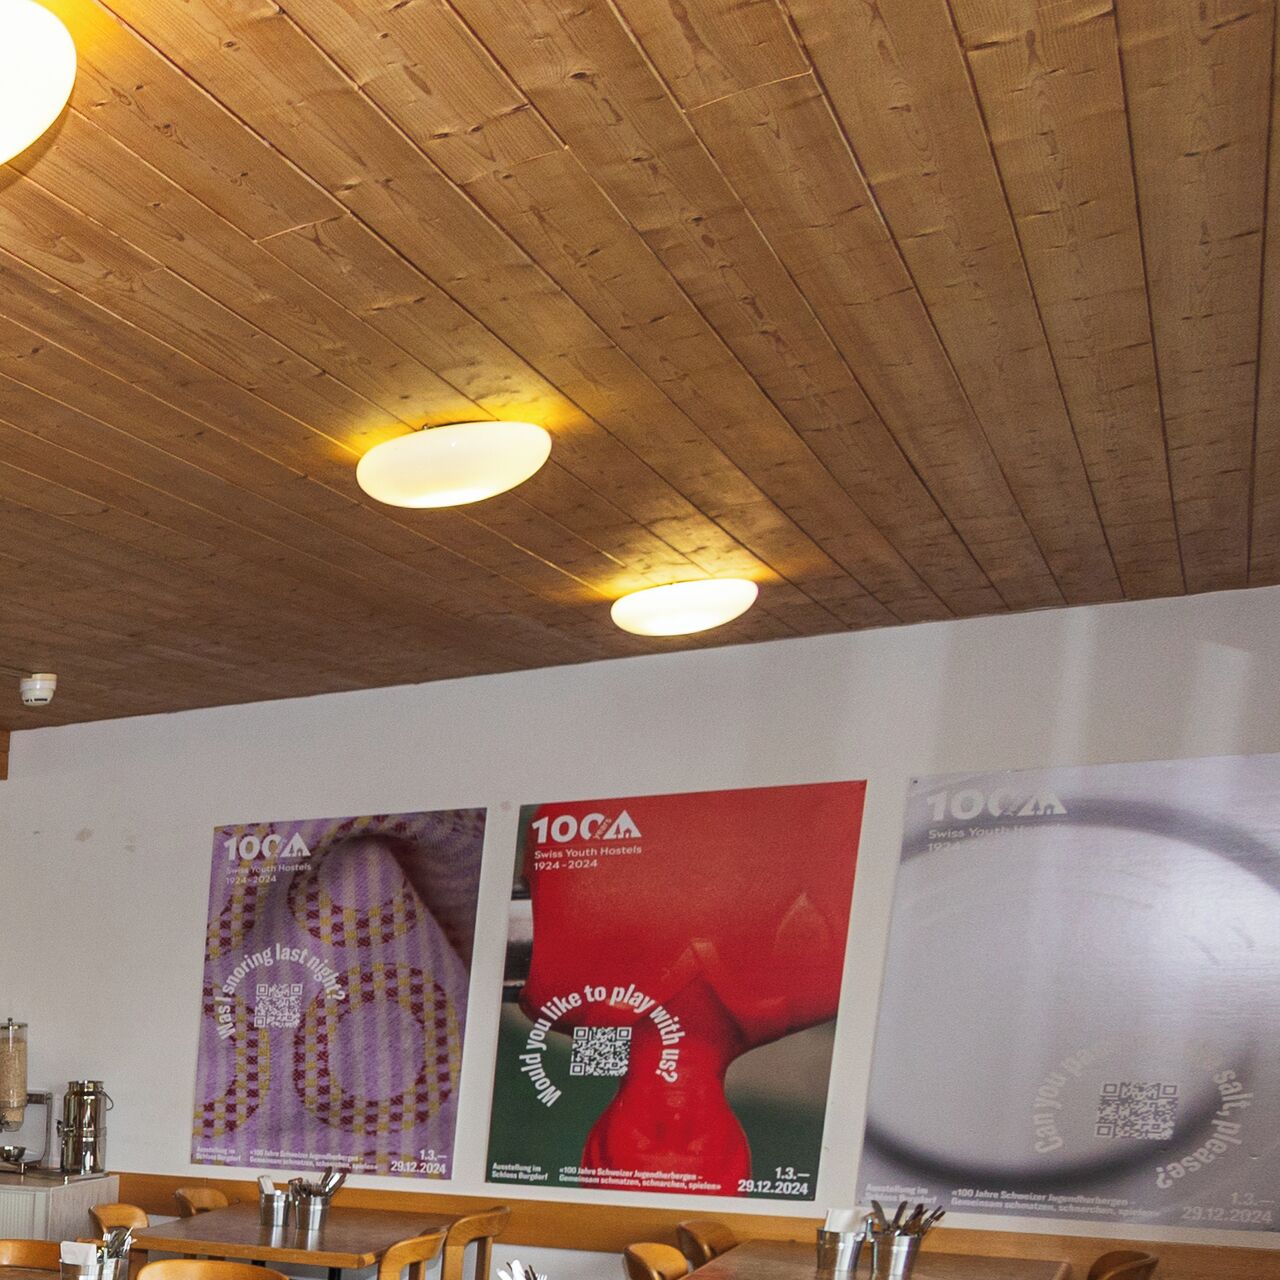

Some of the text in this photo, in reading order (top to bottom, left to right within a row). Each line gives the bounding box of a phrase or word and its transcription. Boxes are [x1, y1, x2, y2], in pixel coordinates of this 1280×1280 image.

[928, 828, 965, 840] Swiss
[534, 845, 642, 860] Swiss Youth Hostels
[251, 865, 277, 874] Youth
[278, 863, 312, 873] Hostels
[275, 943, 309, 965] last
[222, 947, 274, 995] snoring
[306, 956, 346, 1001] night?
[216, 1004, 236, 1040] Was
[519, 983, 686, 1108] Would you like to play with us?
[1211, 1069, 1254, 1117] salt,
[1155, 1118, 1243, 1189] please?
[390, 1160, 446, 1175] 29.12.2024
[492, 1162, 542, 1173] Ausstellung im
[518, 1171, 549, 1181] Burgdorf
[577, 1167, 596, 1176] Jahre
[596, 1168, 633, 1178] Schweizer
[737, 1179, 809, 1196] 29.12.2024
[975, 1189, 1000, 1199] Jahre
[1000, 1190, 1047, 1201] Schweizer
[1181, 1206, 1273, 1224] 29.12.2024
